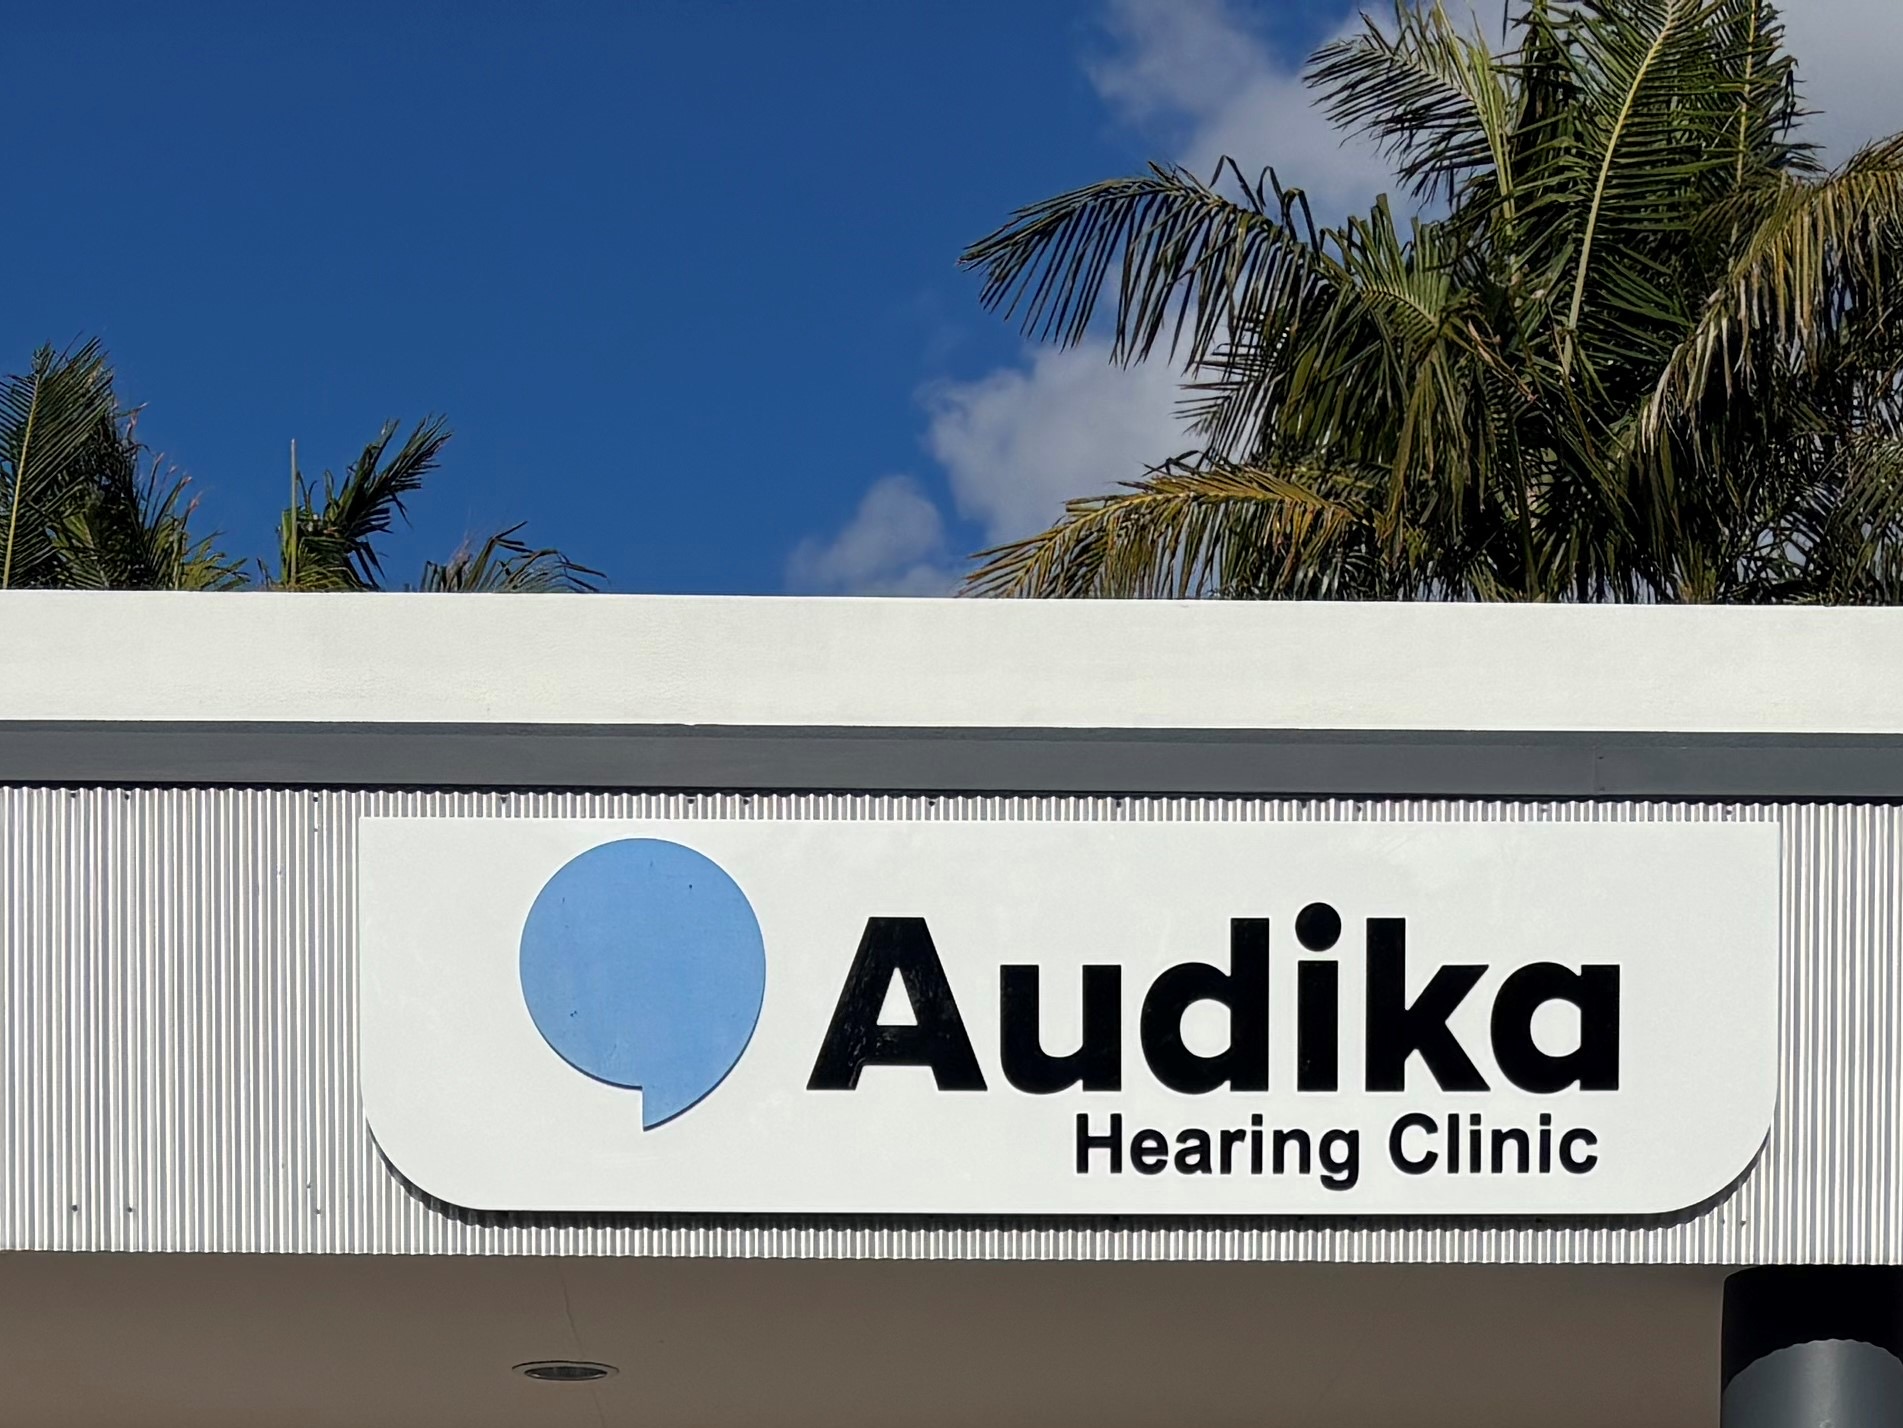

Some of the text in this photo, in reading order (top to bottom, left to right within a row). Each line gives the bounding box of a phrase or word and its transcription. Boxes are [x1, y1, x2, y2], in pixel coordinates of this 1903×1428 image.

[805, 901, 1622, 1096] Audika
[1075, 1110, 1599, 1191] Hearing Clinic
